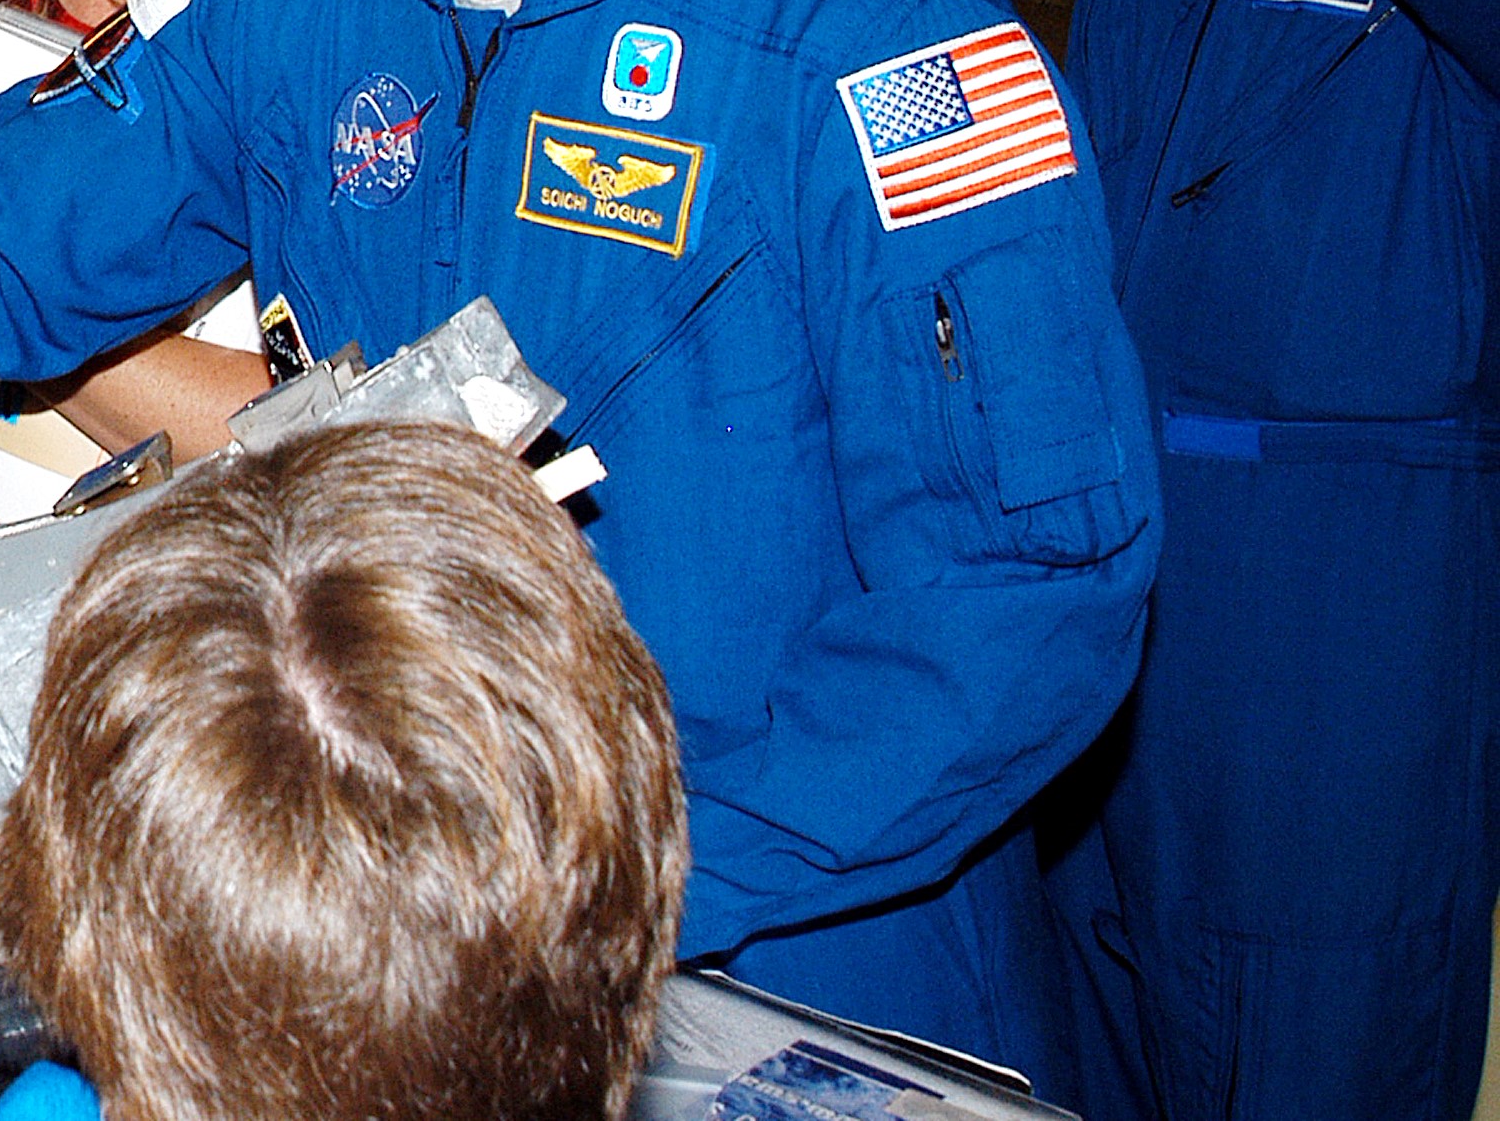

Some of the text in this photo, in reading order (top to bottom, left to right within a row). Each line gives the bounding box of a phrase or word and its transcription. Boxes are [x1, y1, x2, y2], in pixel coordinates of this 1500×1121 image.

[335, 122, 417, 166] NASA
[541, 187, 663, 230] SOICHI NOGUCHI
